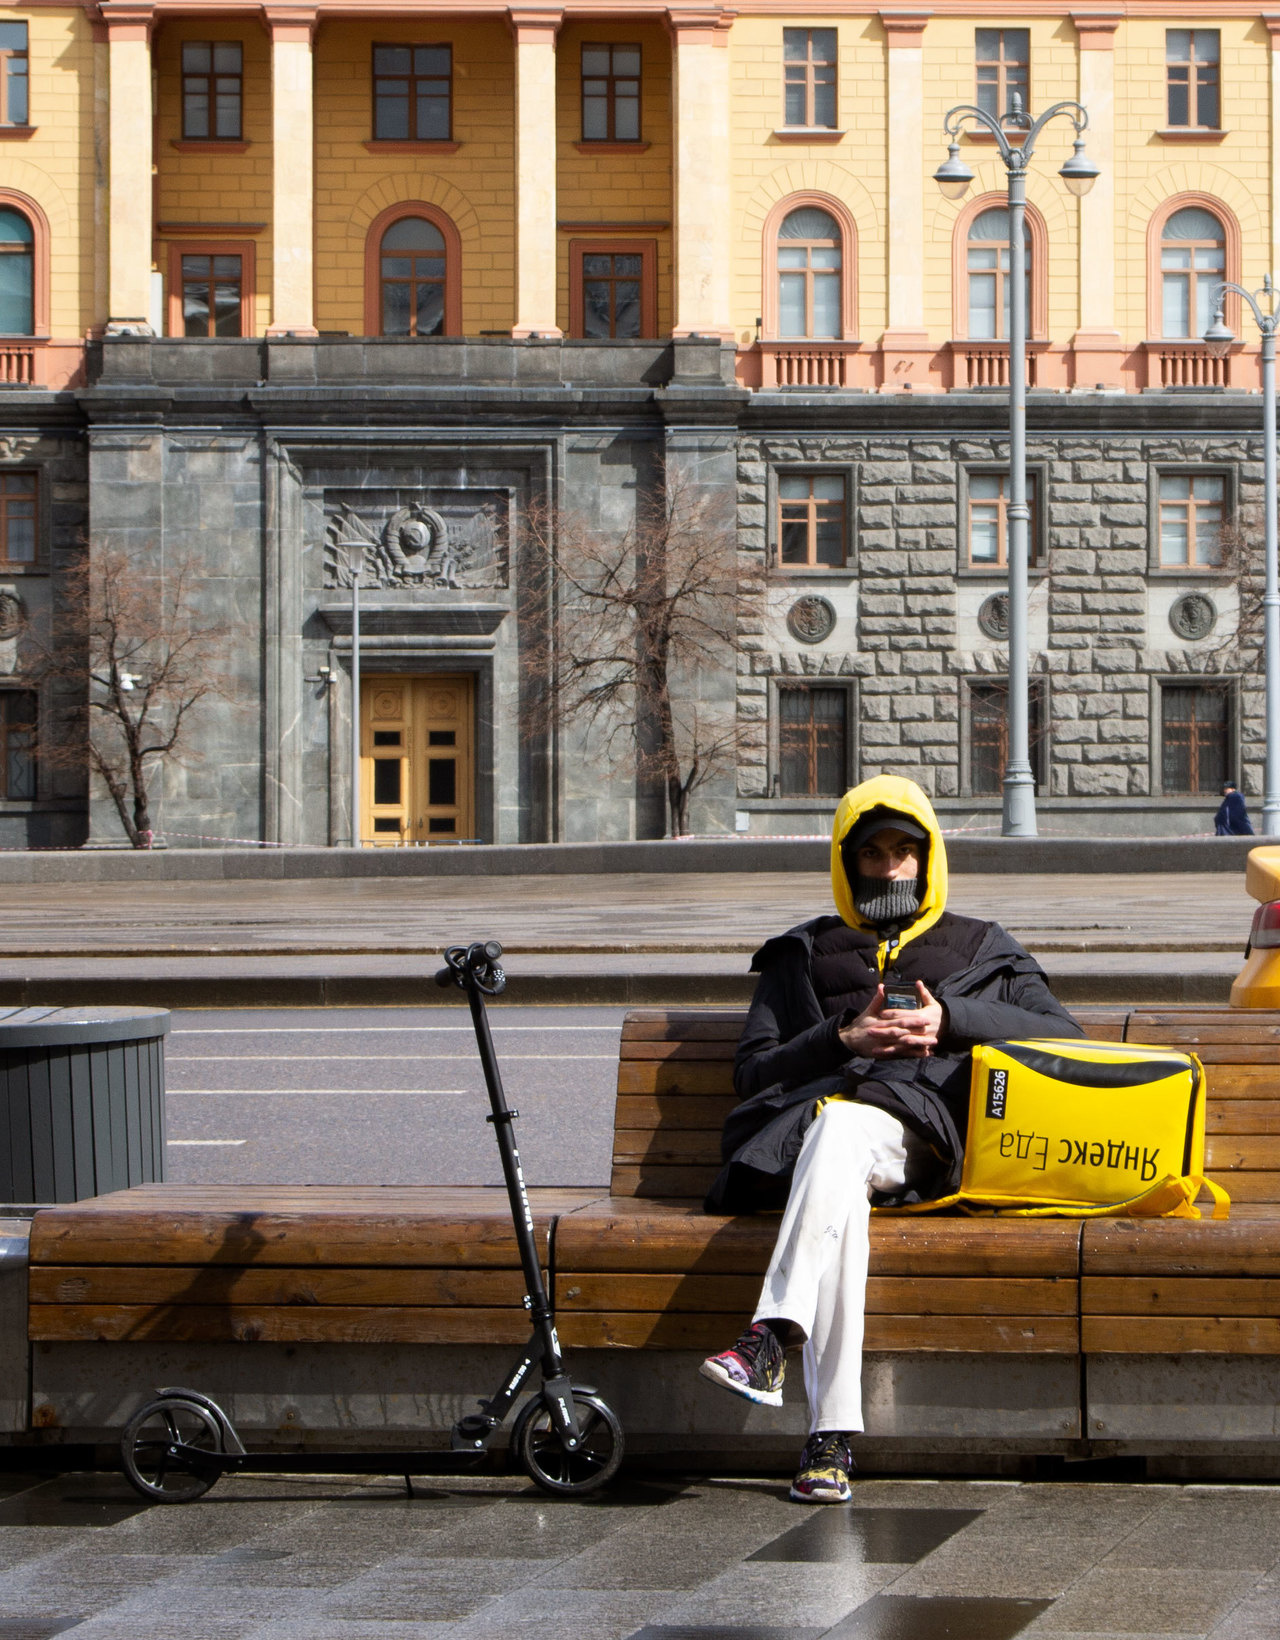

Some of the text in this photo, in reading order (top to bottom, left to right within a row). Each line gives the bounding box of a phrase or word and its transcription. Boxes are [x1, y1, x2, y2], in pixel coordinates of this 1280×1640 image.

[991, 1070, 1006, 1118] A15626
[1000, 1130, 1160, 1182] Яндекс Еда
